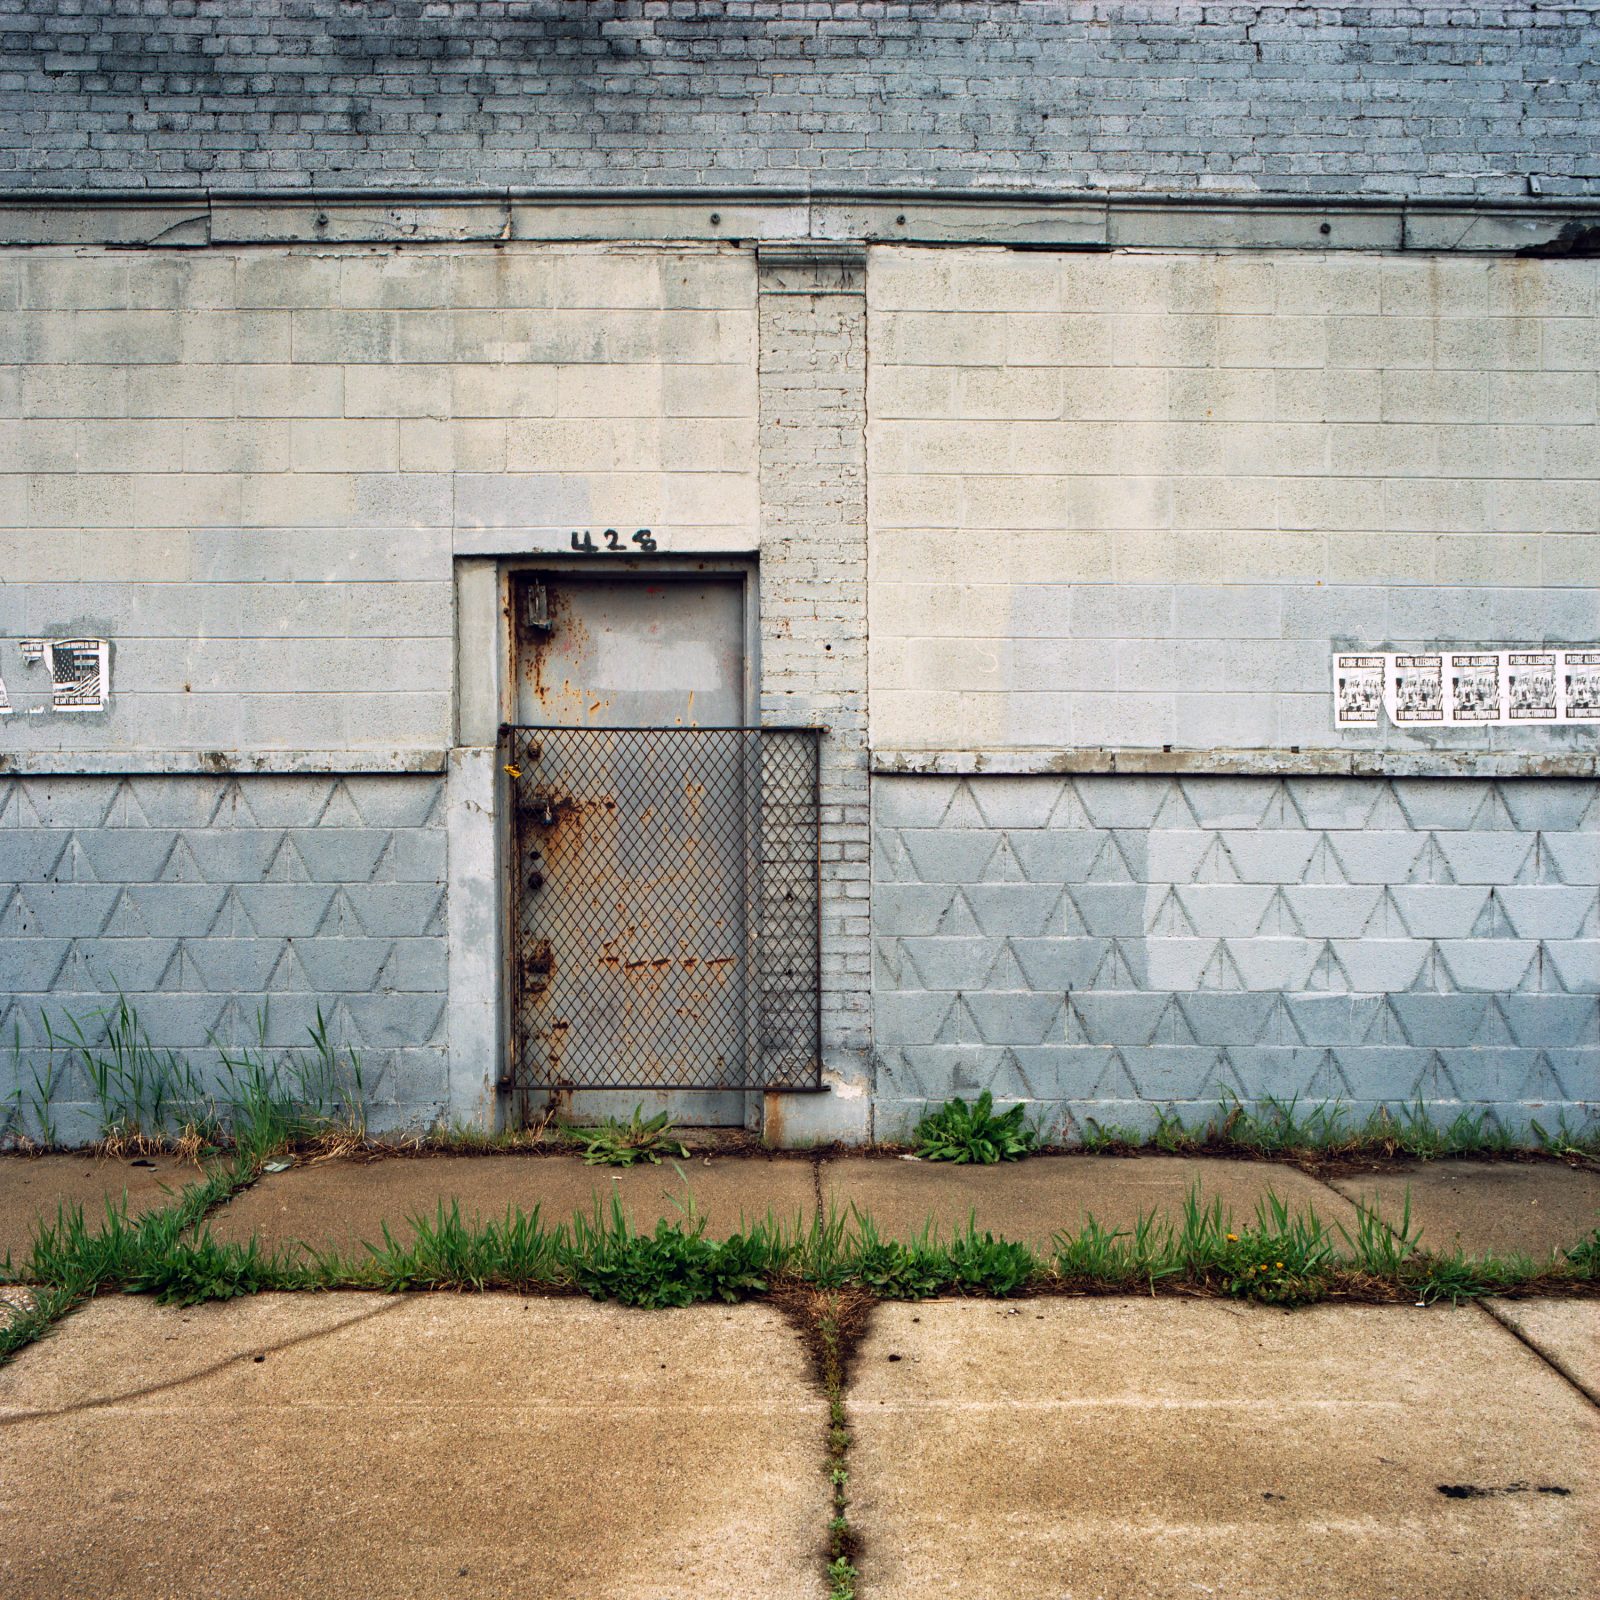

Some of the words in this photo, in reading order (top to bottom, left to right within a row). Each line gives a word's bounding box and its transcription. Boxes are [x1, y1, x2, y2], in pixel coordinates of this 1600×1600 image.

[1357, 658, 1385, 667] ALLEGIANCE
[1414, 657, 1442, 666] ALLEGIANCE
[1471, 656, 1498, 666] ALLEGIANCE
[1527, 655, 1555, 665] ALLEGIANCE
